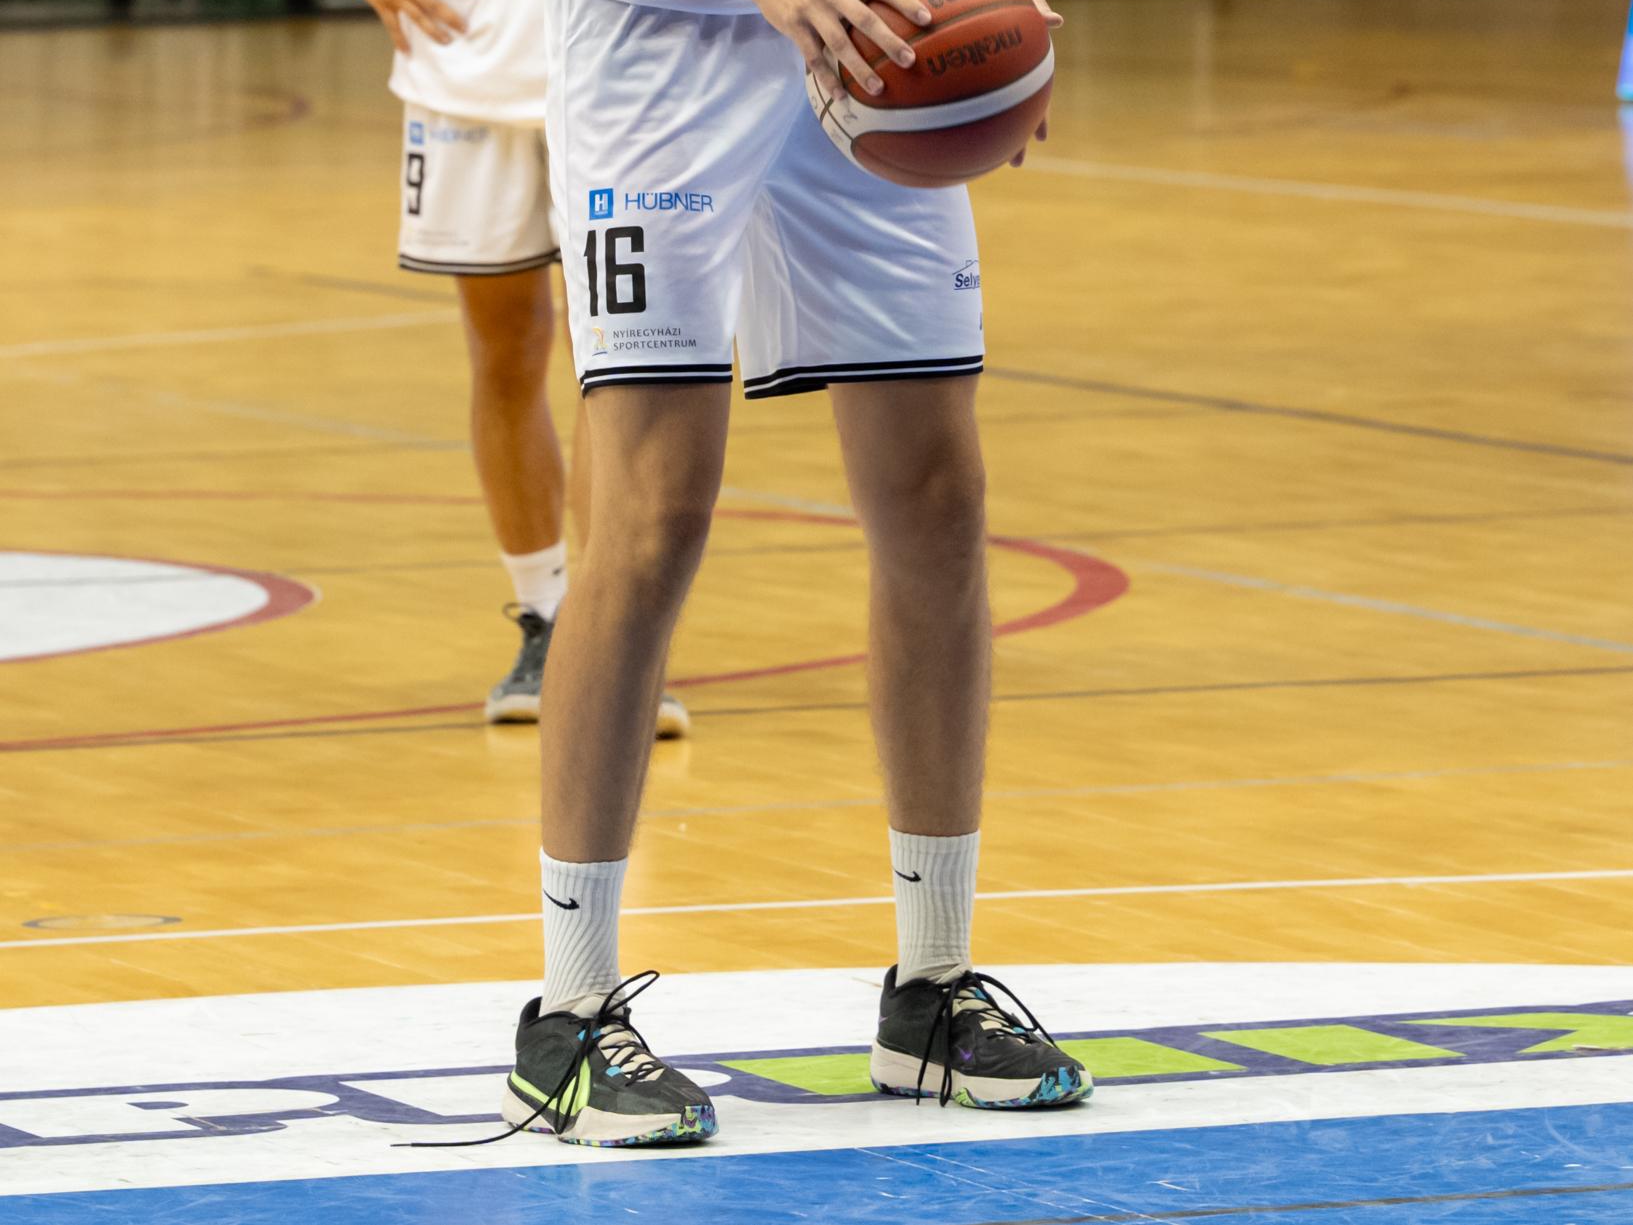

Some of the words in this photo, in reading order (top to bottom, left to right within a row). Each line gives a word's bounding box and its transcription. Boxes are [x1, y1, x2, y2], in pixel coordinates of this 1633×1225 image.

[926, 26, 1023, 75] molten
[407, 153, 424, 216] 9
[625, 192, 713, 212] HÜBNER
[584, 226, 646, 317] 16
[612, 327, 681, 338] NYÍREGYHÁZI
[613, 339, 697, 351] SPORTCENTRUM
